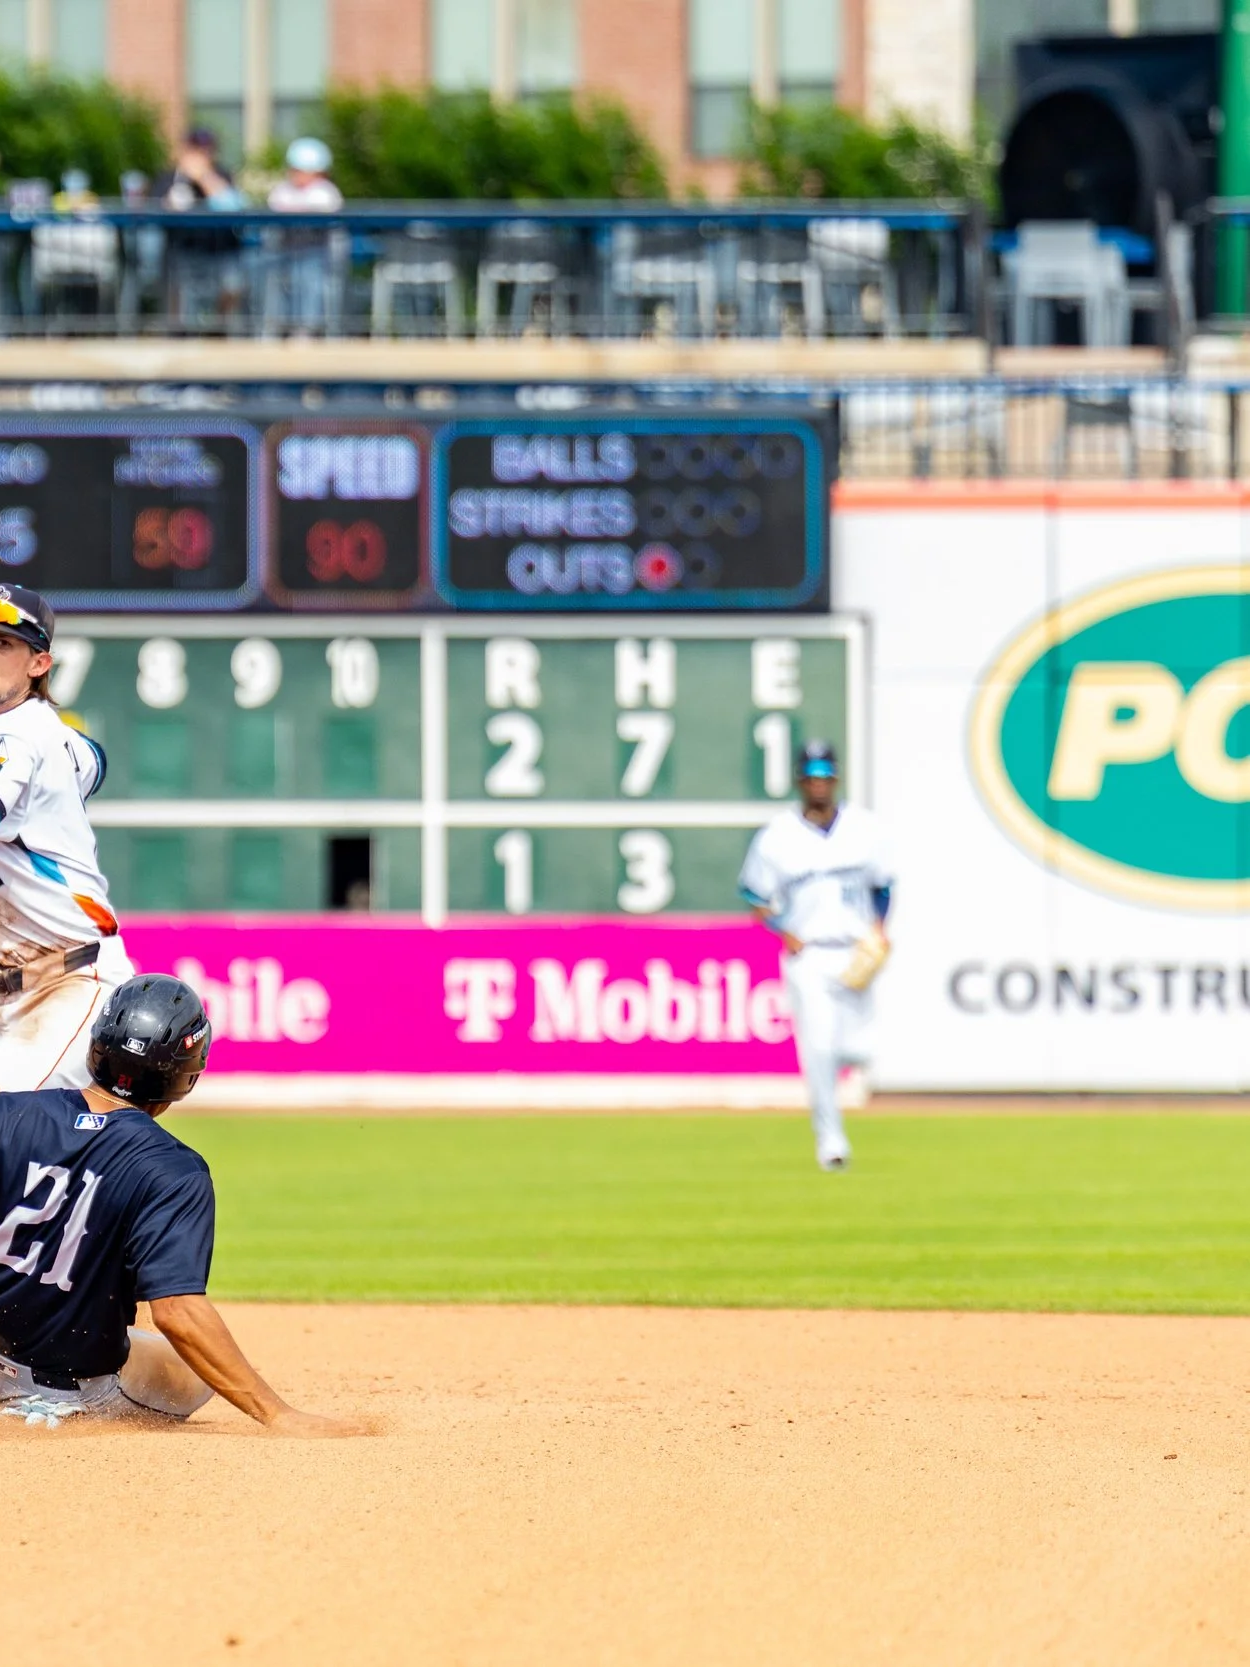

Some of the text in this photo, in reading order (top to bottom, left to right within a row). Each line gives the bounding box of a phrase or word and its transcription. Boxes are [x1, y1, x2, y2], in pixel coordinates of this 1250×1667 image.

[278, 436, 419, 497] SPEED
[492, 432, 634, 481] BALLS
[450, 488, 635, 537] STRIKES
[306, 520, 386, 581] 90
[507, 542, 634, 592] OUTS
[53, 638, 94, 706] 7
[137, 638, 187, 707] 8
[231, 638, 281, 707] 9
[326, 638, 379, 707] 10
[485, 638, 801, 708] R H E
[485, 712, 792, 798] 2 7 1
[493, 829, 674, 913] 1 3
[172, 956, 331, 1044] bile
[444, 957, 792, 1043] T Mobile
